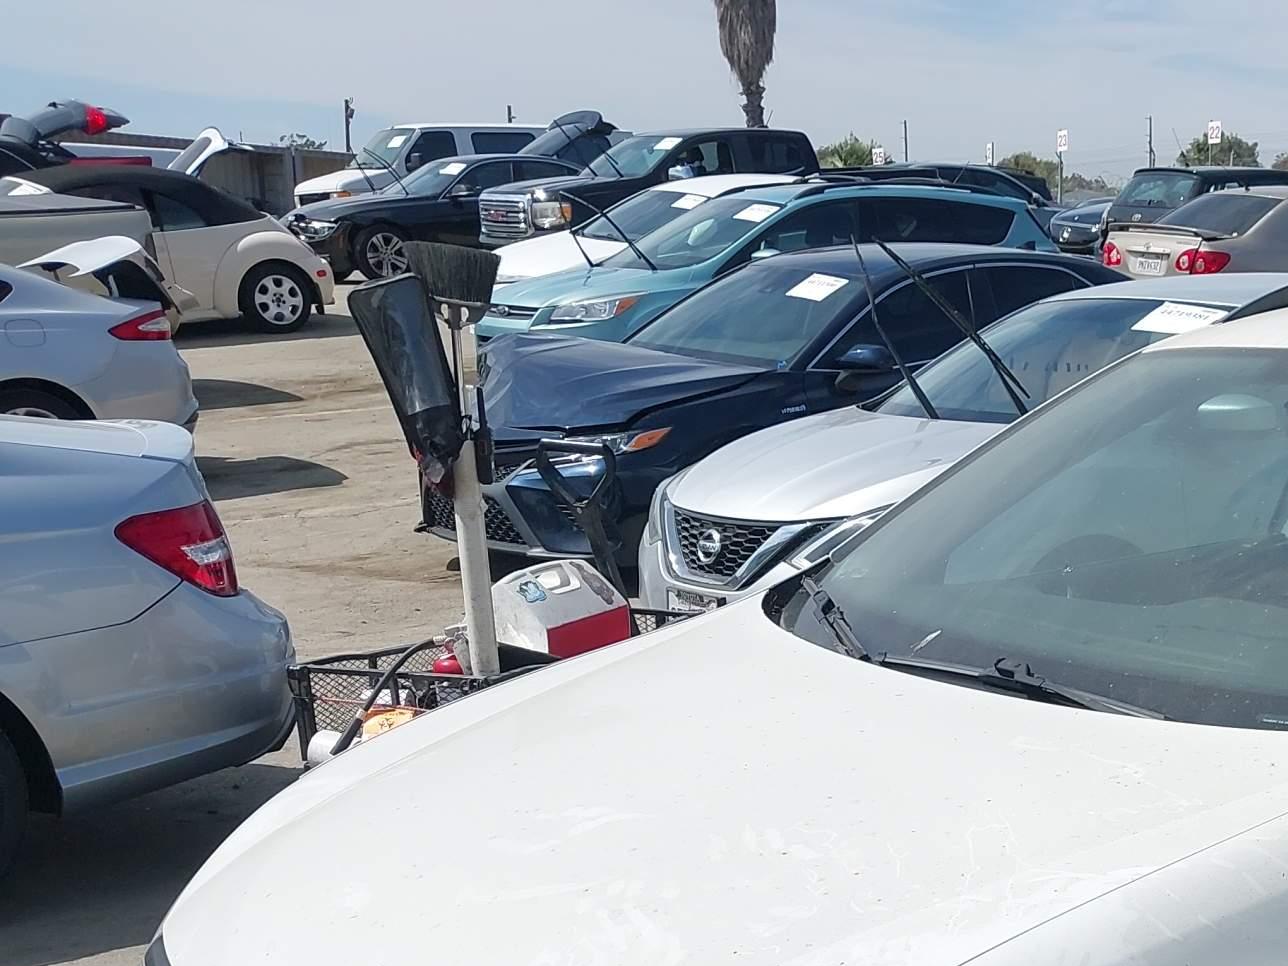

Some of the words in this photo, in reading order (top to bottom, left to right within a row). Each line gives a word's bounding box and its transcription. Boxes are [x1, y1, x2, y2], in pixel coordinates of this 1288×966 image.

[1209, 126, 1221, 139] 22
[1058, 135, 1067, 147] 23
[874, 151, 884, 163] 25
